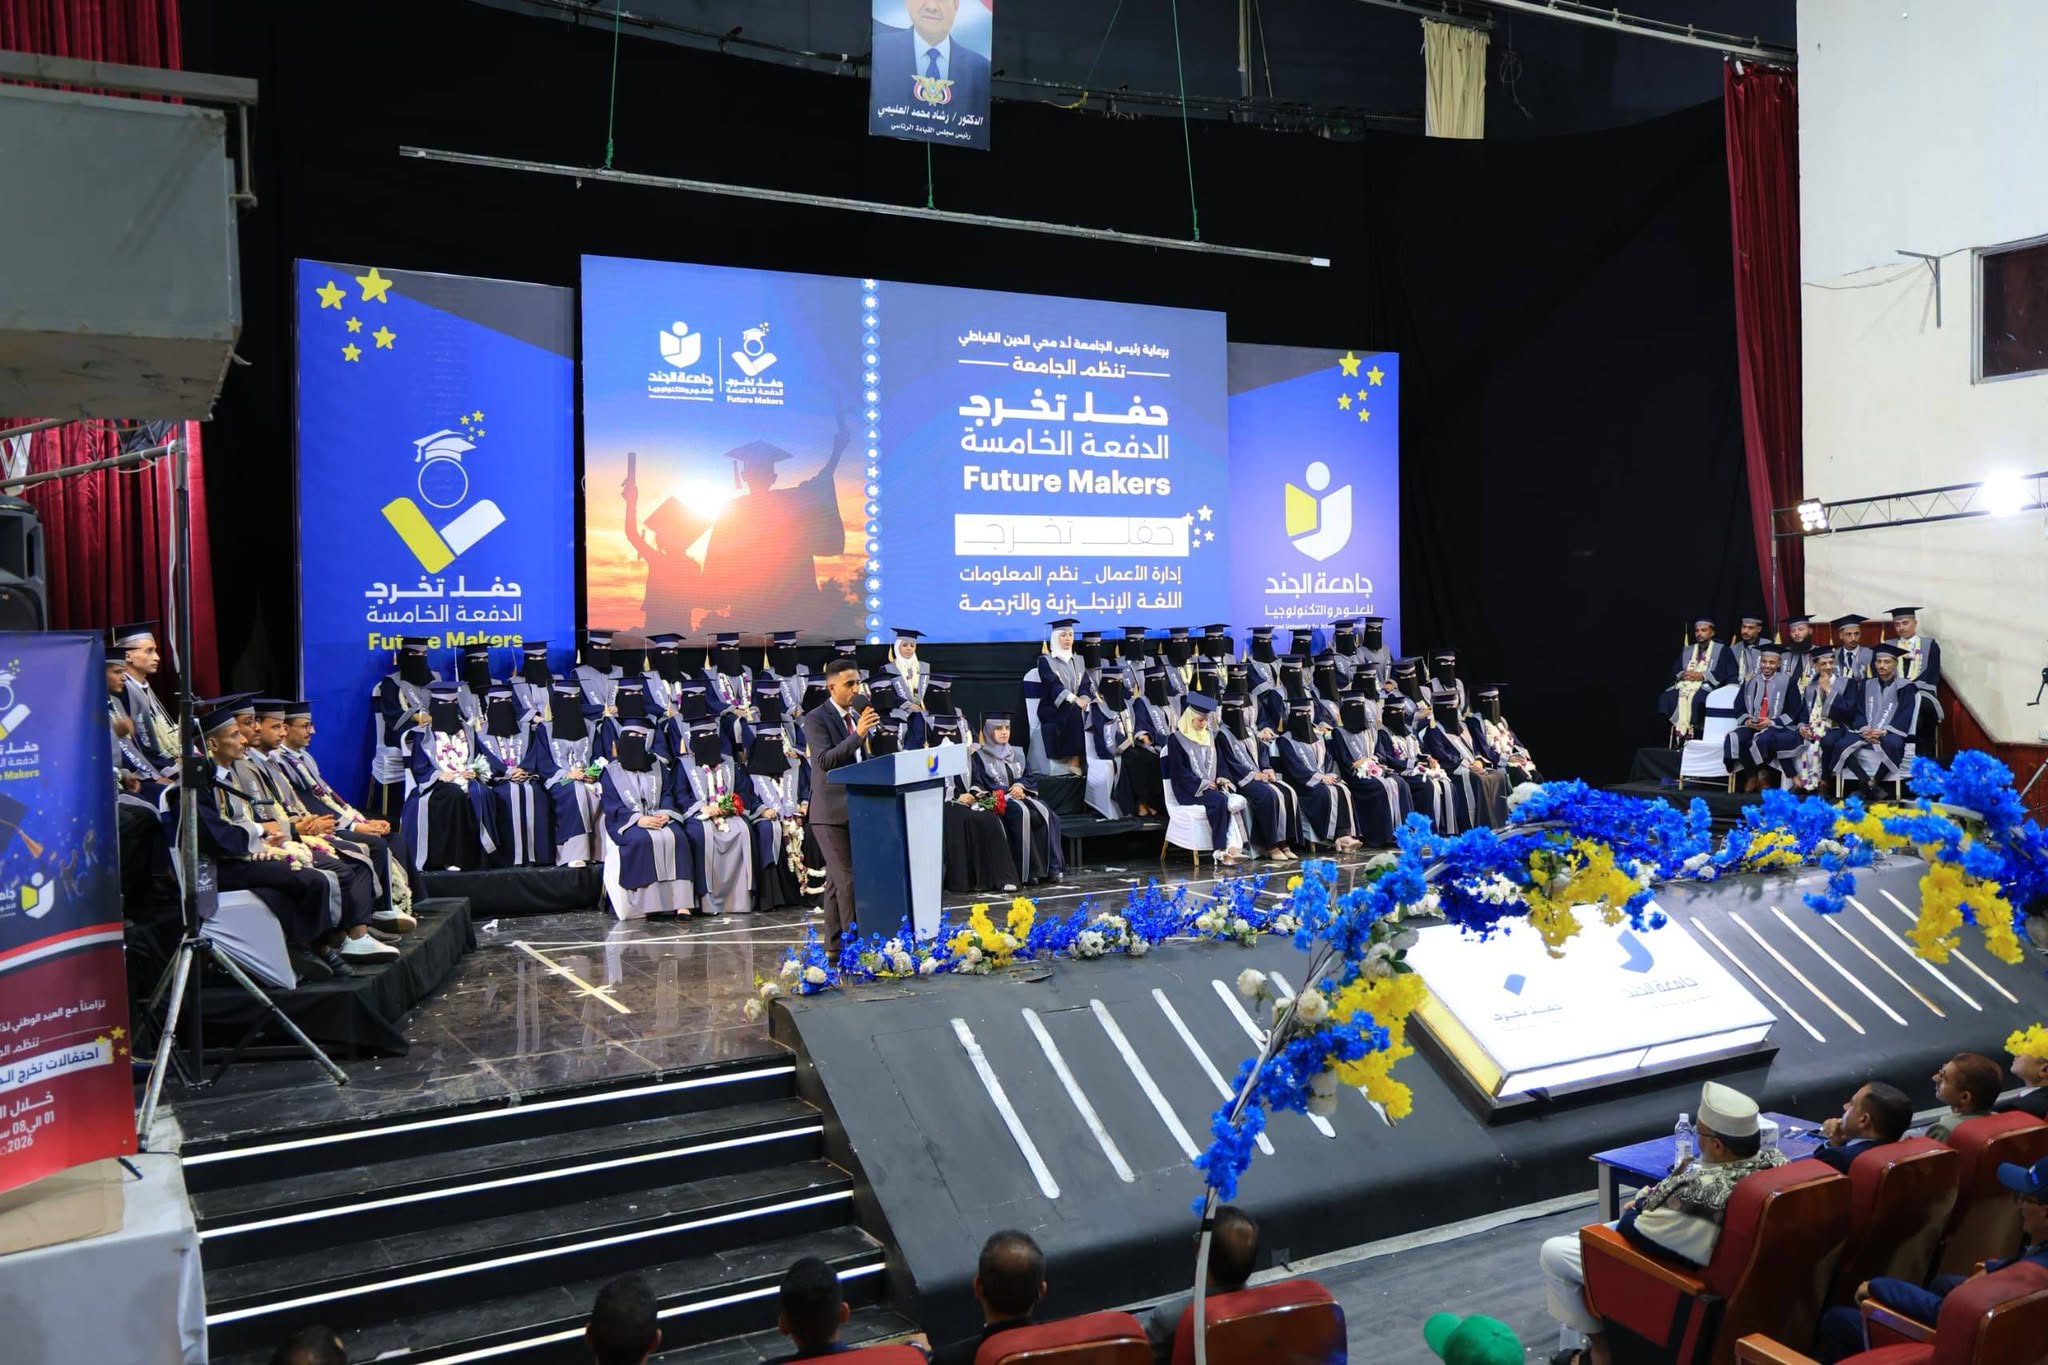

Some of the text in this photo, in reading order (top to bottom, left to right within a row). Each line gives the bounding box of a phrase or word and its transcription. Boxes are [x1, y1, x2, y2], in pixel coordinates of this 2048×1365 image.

[877, 104, 910, 118] العليمي
[911, 108, 930, 119] محمد
[932, 110, 950, 124] رشاد
[958, 114, 984, 126] الدكتور
[958, 329, 1001, 347] القباطي
[1003, 334, 1031, 347] الدين
[1032, 338, 1057, 353] محي
[1073, 338, 1113, 354] الجامعة
[1114, 342, 1140, 356] رئيس
[1142, 344, 1169, 359] برعاية
[1012, 355, 1126, 380] تنظم الجامعة
[679, 371, 714, 386] جامعة
[958, 388, 1169, 427] حفل تخرج
[960, 428, 1169, 459] الدفعة الخامسة
[963, 466, 1171, 496] Future Makers
[959, 565, 1042, 586] المعلومات
[1046, 566, 1079, 586] نظم
[1095, 565, 1148, 582] الأعمال
[1151, 566, 1182, 585] إدارة
[365, 575, 522, 605] حفل تخرج
[1264, 571, 1373, 599] جامعة الجند
[958, 590, 1182, 616] اللغة الإنجليزية والترجمة
[1264, 603, 1374, 618] للعلوم والتكنولوجيا
[366, 604, 522, 623] الدفعة الخامسة
[368, 633, 441, 650] Fute
[5, 741, 39, 754] حفل
[4, 770, 40, 780] Makers
[43, 1007, 63, 1021] العيد
[65, 1007, 78, 1018] مع
[12, 1013, 41, 1033] الوطني
[12, 1037, 39, 1053] تنظم
[46, 1048, 99, 1070] احتفالات
[17, 1063, 42, 1083] تخرج
[10, 1091, 54, 1118] خلال
[44, 1110, 54, 1124] 01
